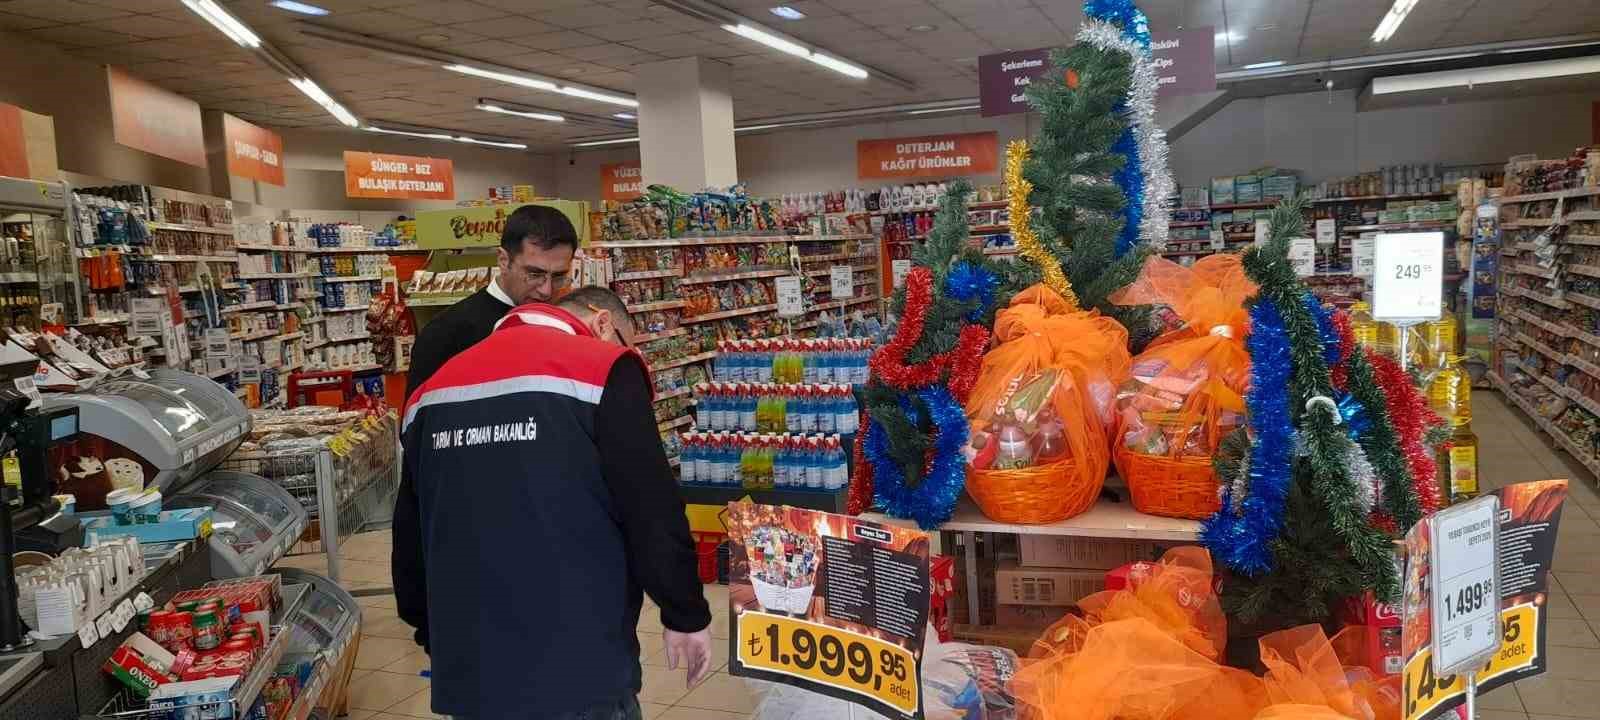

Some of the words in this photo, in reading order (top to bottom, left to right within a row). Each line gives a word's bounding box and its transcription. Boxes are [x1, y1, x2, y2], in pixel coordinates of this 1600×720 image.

[1014, 75, 1032, 87] Kek
[896, 141, 955, 154] DETERJAN
[371, 158, 408, 174] SÜNGER
[415, 162, 432, 175] BEZ
[880, 158, 917, 171] KAĞIT
[918, 155, 971, 169] ÜRÜNLER
[358, 177, 397, 193] BULAŞIK
[398, 179, 444, 193] DETERJANI
[1395, 264, 1421, 280] 249
[431, 430, 451, 450] TARIM
[453, 429, 464, 447] VE
[465, 425, 493, 446] ORMAN
[493, 416, 537, 442] BAKANLIĞI
[1444, 582, 1483, 621] 1.499
[1500, 643, 1527, 661] adet
[889, 682, 912, 702] adet
